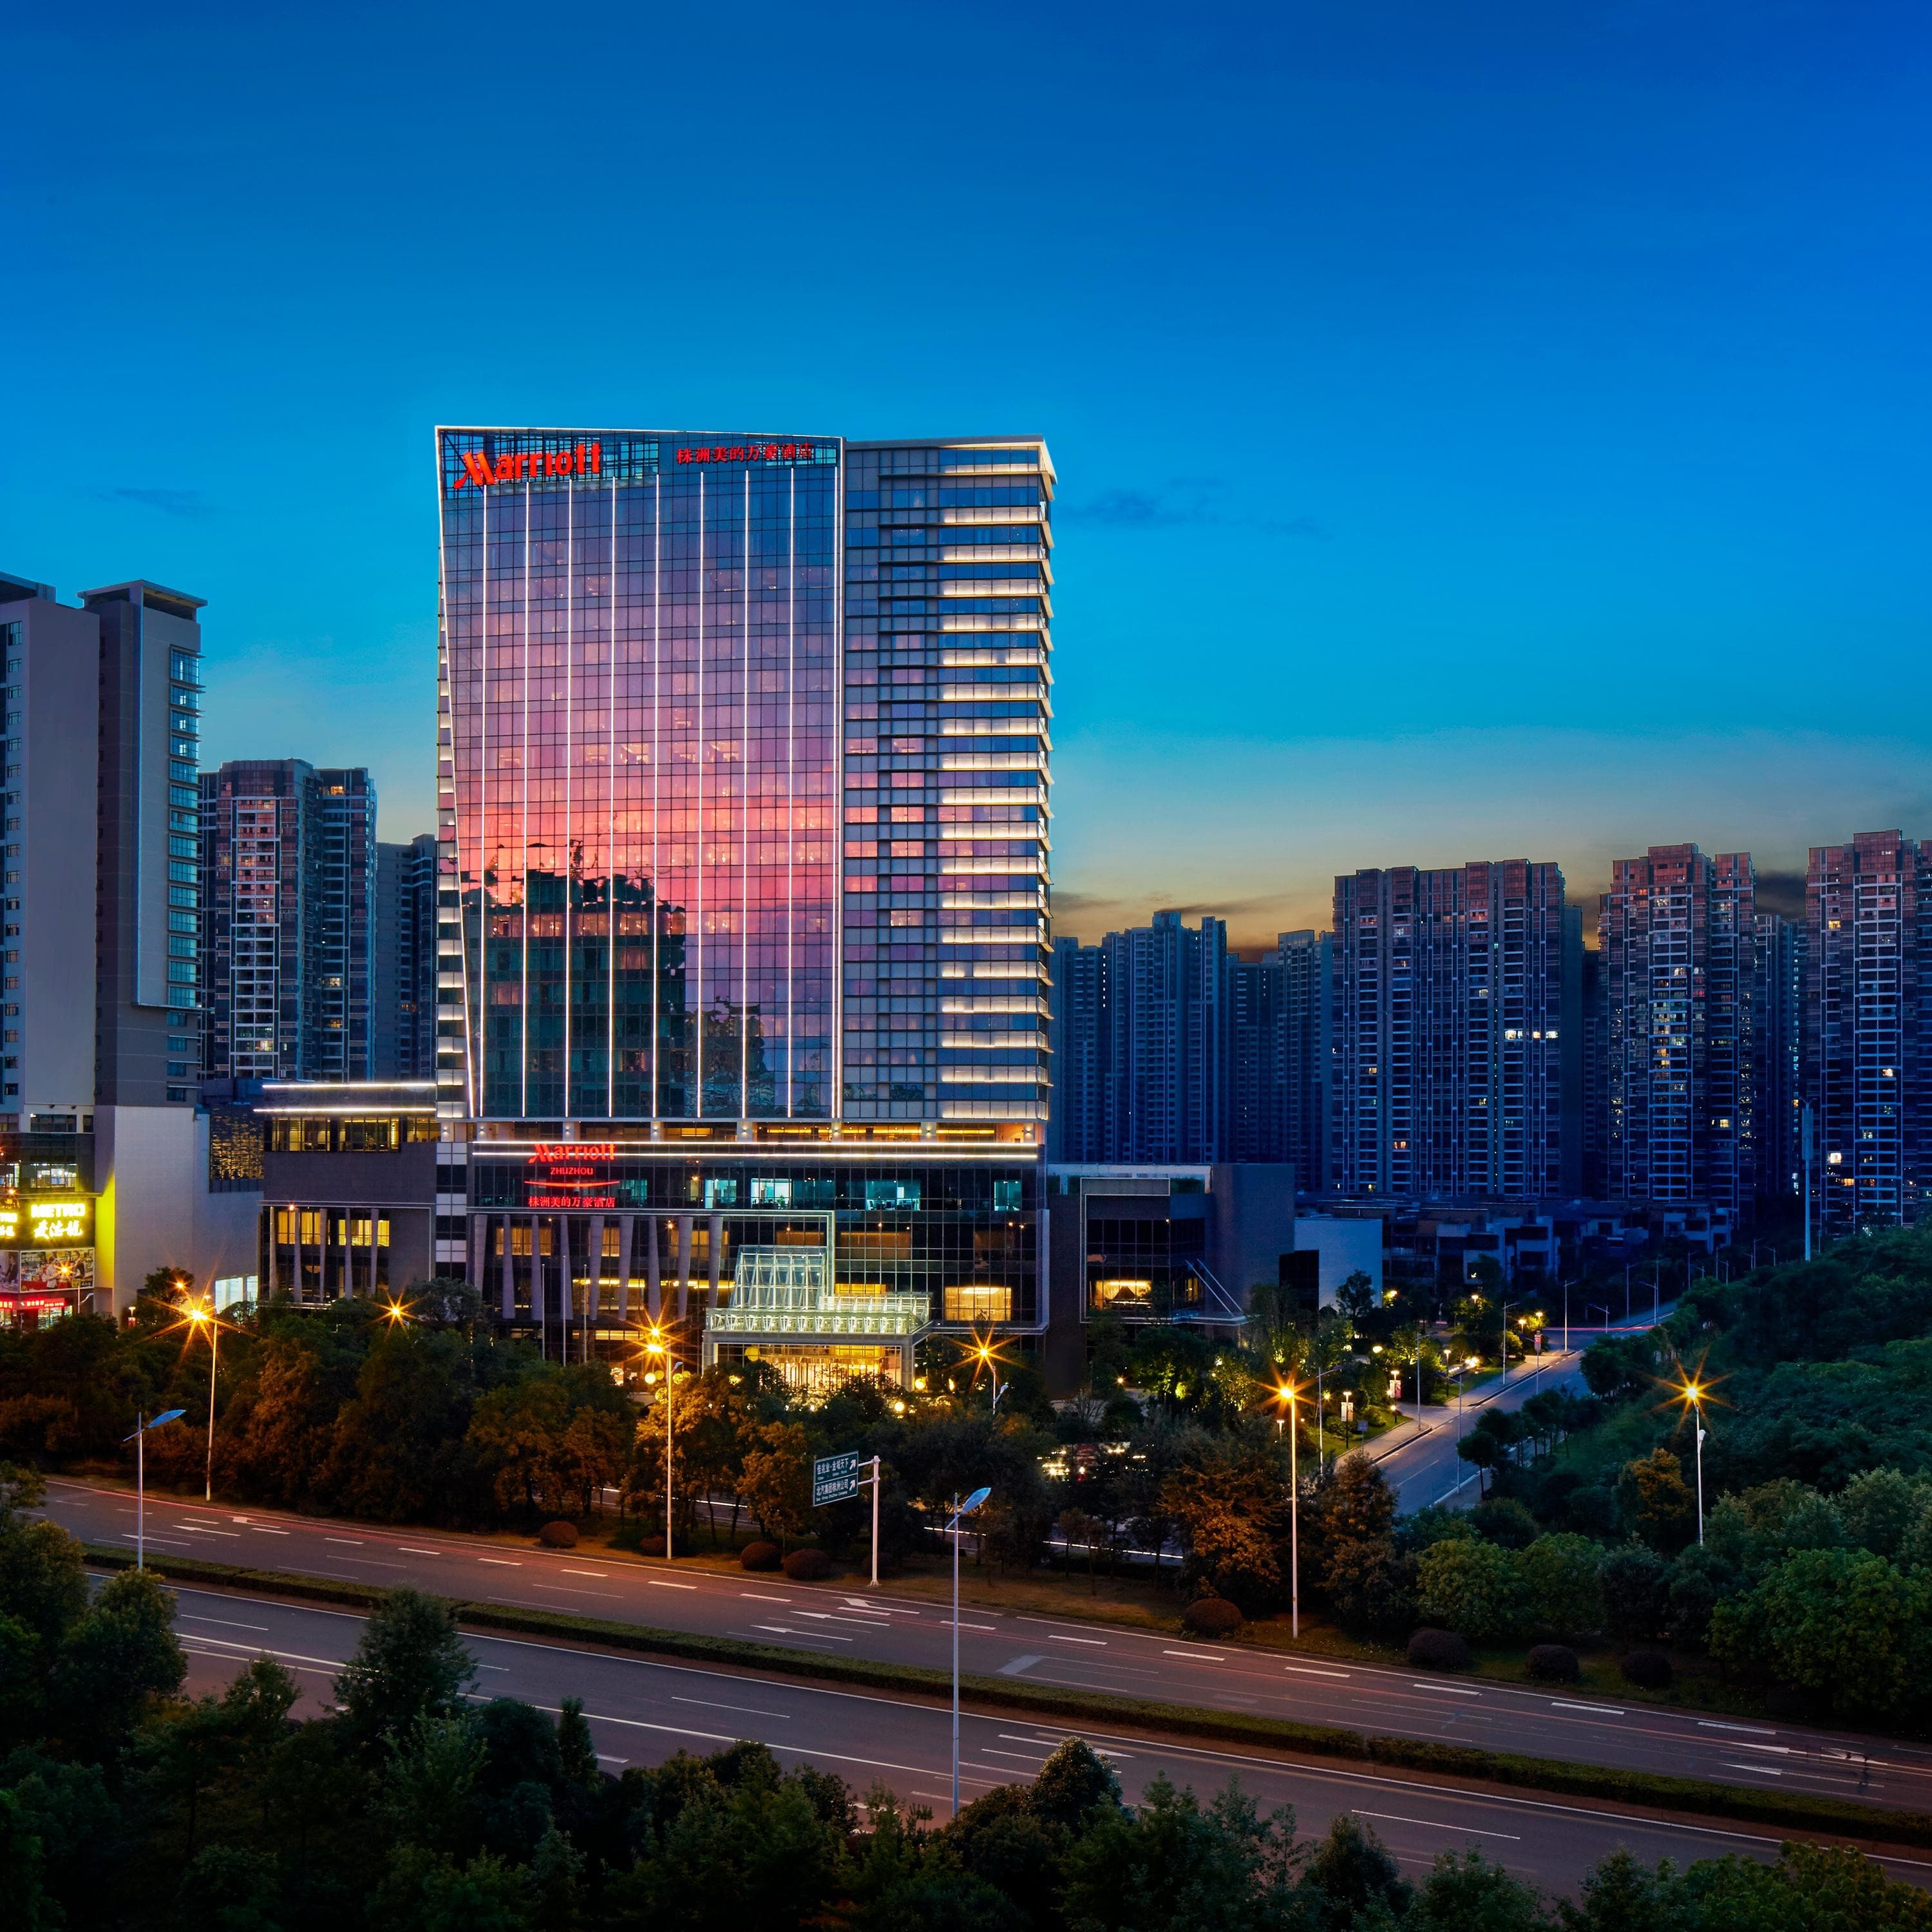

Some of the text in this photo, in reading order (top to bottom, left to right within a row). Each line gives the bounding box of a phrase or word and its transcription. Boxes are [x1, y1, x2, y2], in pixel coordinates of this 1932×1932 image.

[677, 442, 813, 464] 株洲美的万豪酒店
[453, 442, 601, 489] Marriott
[528, 1144, 616, 1164] Marriott
[551, 1167, 594, 1175] ZHUZHOU
[528, 1196, 616, 1208] 株洲美的万豪酒店
[31, 1204, 86, 1218] METRO
